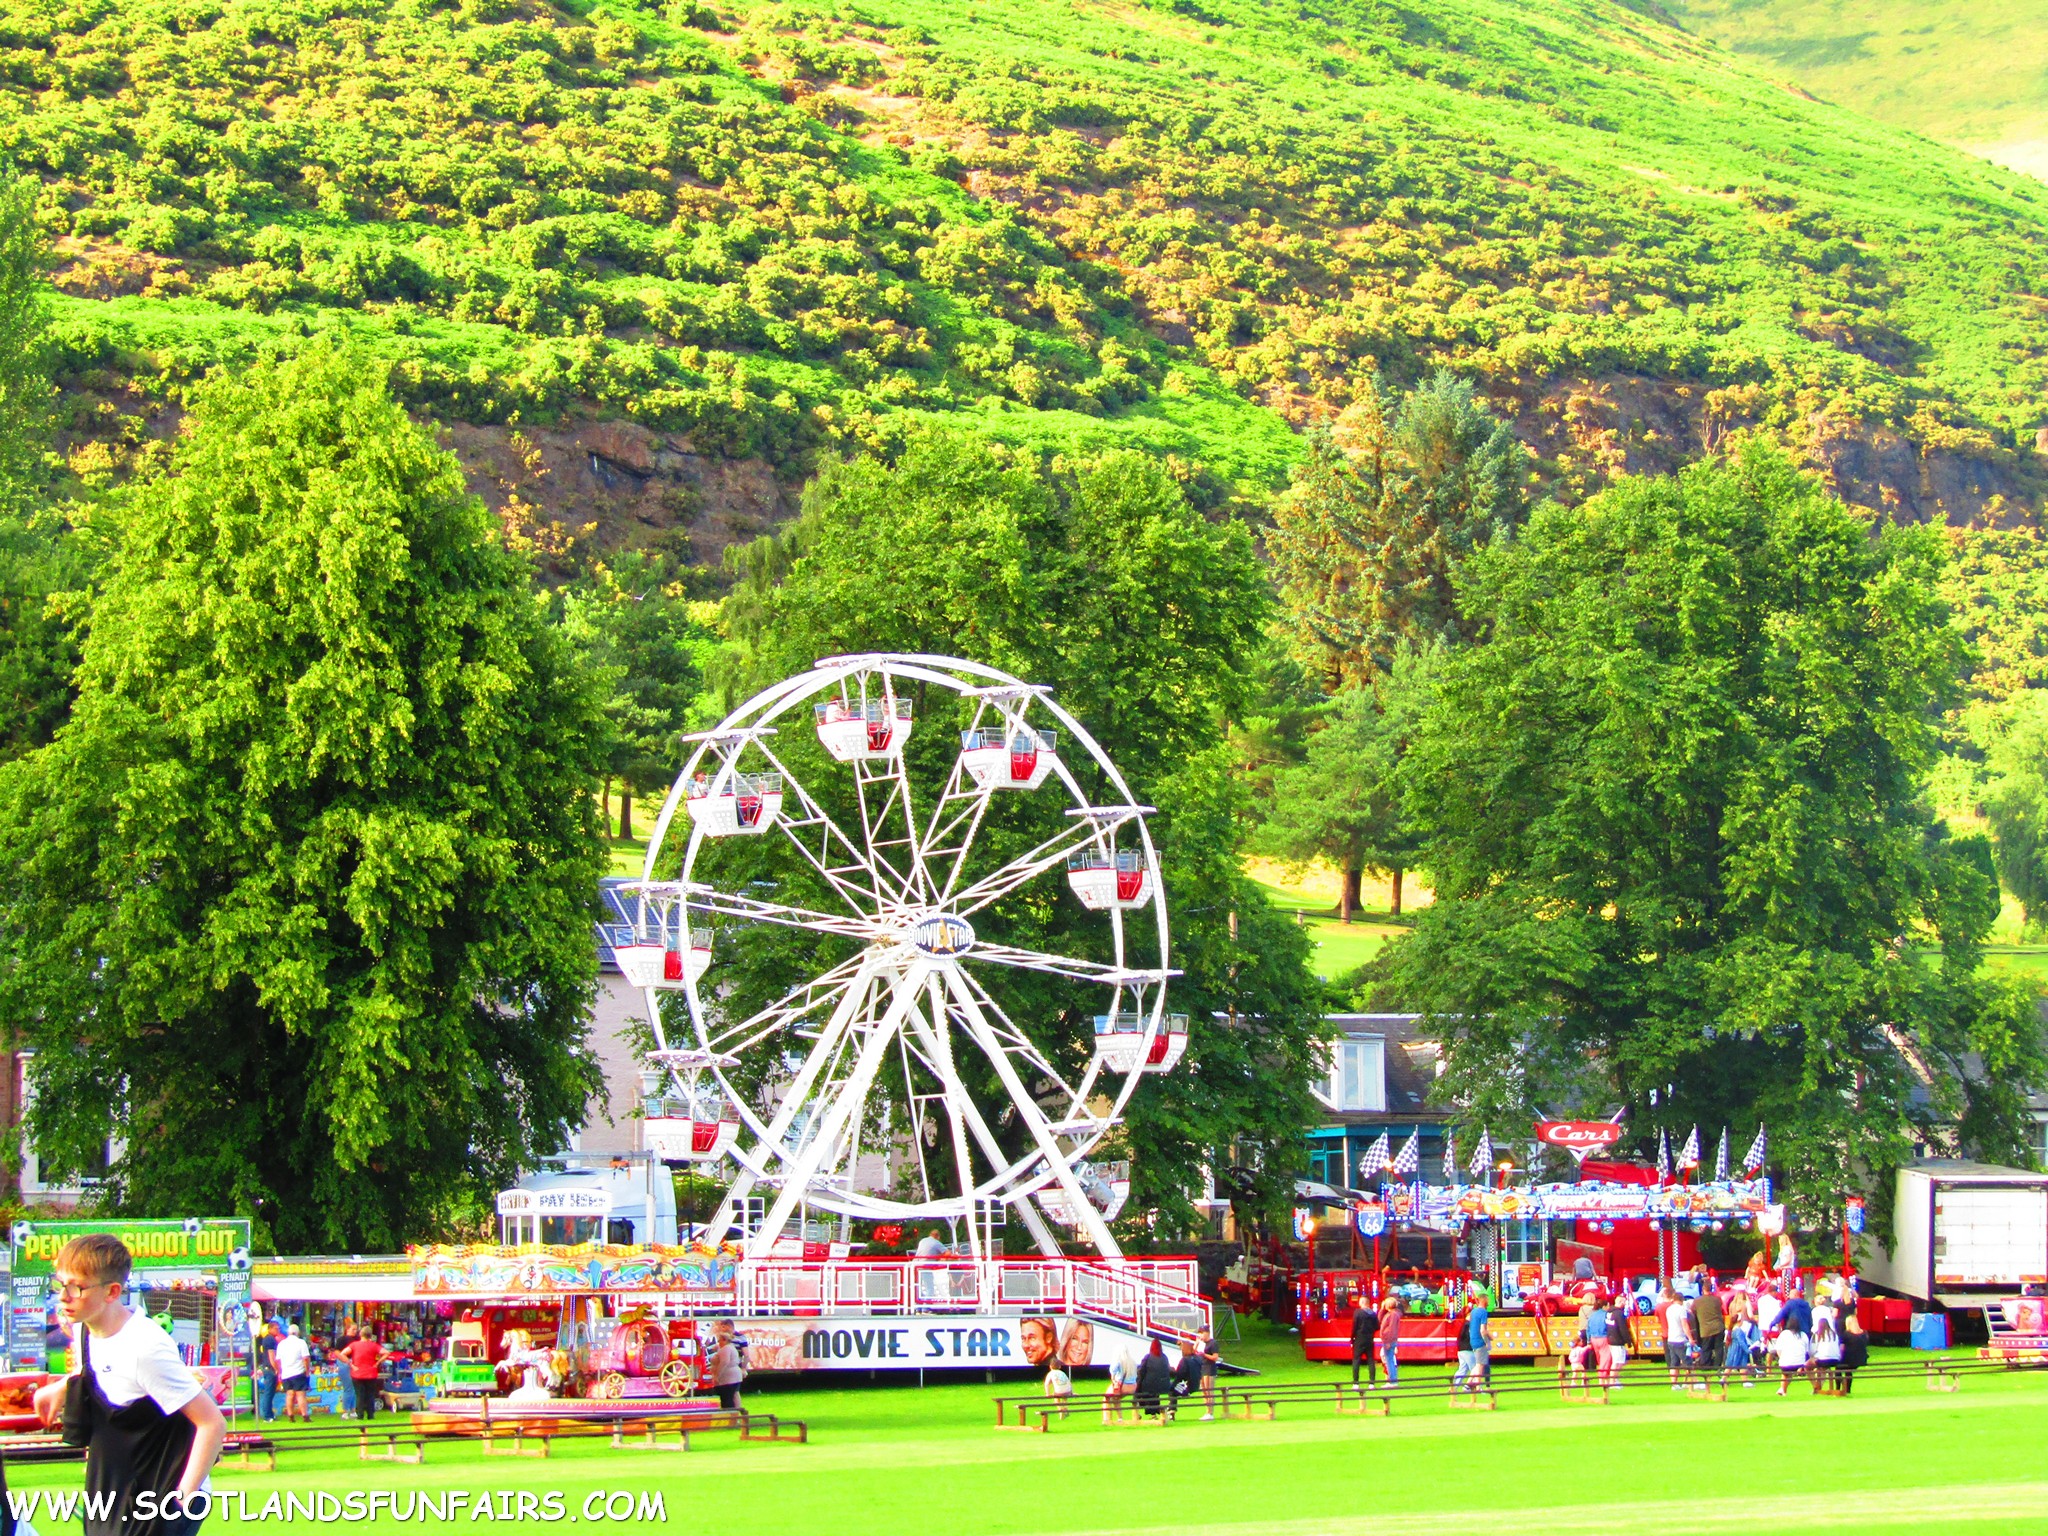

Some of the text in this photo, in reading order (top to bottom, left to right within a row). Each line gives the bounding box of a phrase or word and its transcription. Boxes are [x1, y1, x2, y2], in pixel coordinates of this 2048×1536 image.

[946, 922, 971, 948] STAR
[1548, 1125, 1612, 1140] Cars
[540, 1193, 566, 1208] PAY
[1364, 1218, 1380, 1232] 66
[25, 1229, 237, 1261] PEN SHOOT OUT
[13, 1276, 45, 1287] PENALTY
[220, 1271, 250, 1282] PENALTY
[16, 1286, 41, 1296] SHOOT
[224, 1281, 247, 1291] SHOOT
[22, 1296, 36, 1306] OUT
[229, 1291, 242, 1301] OUT
[802, 1328, 1012, 1359] MOVIE STAR
[316, 1376, 344, 1392] DUC
[414, 1372, 441, 1387] HOO
